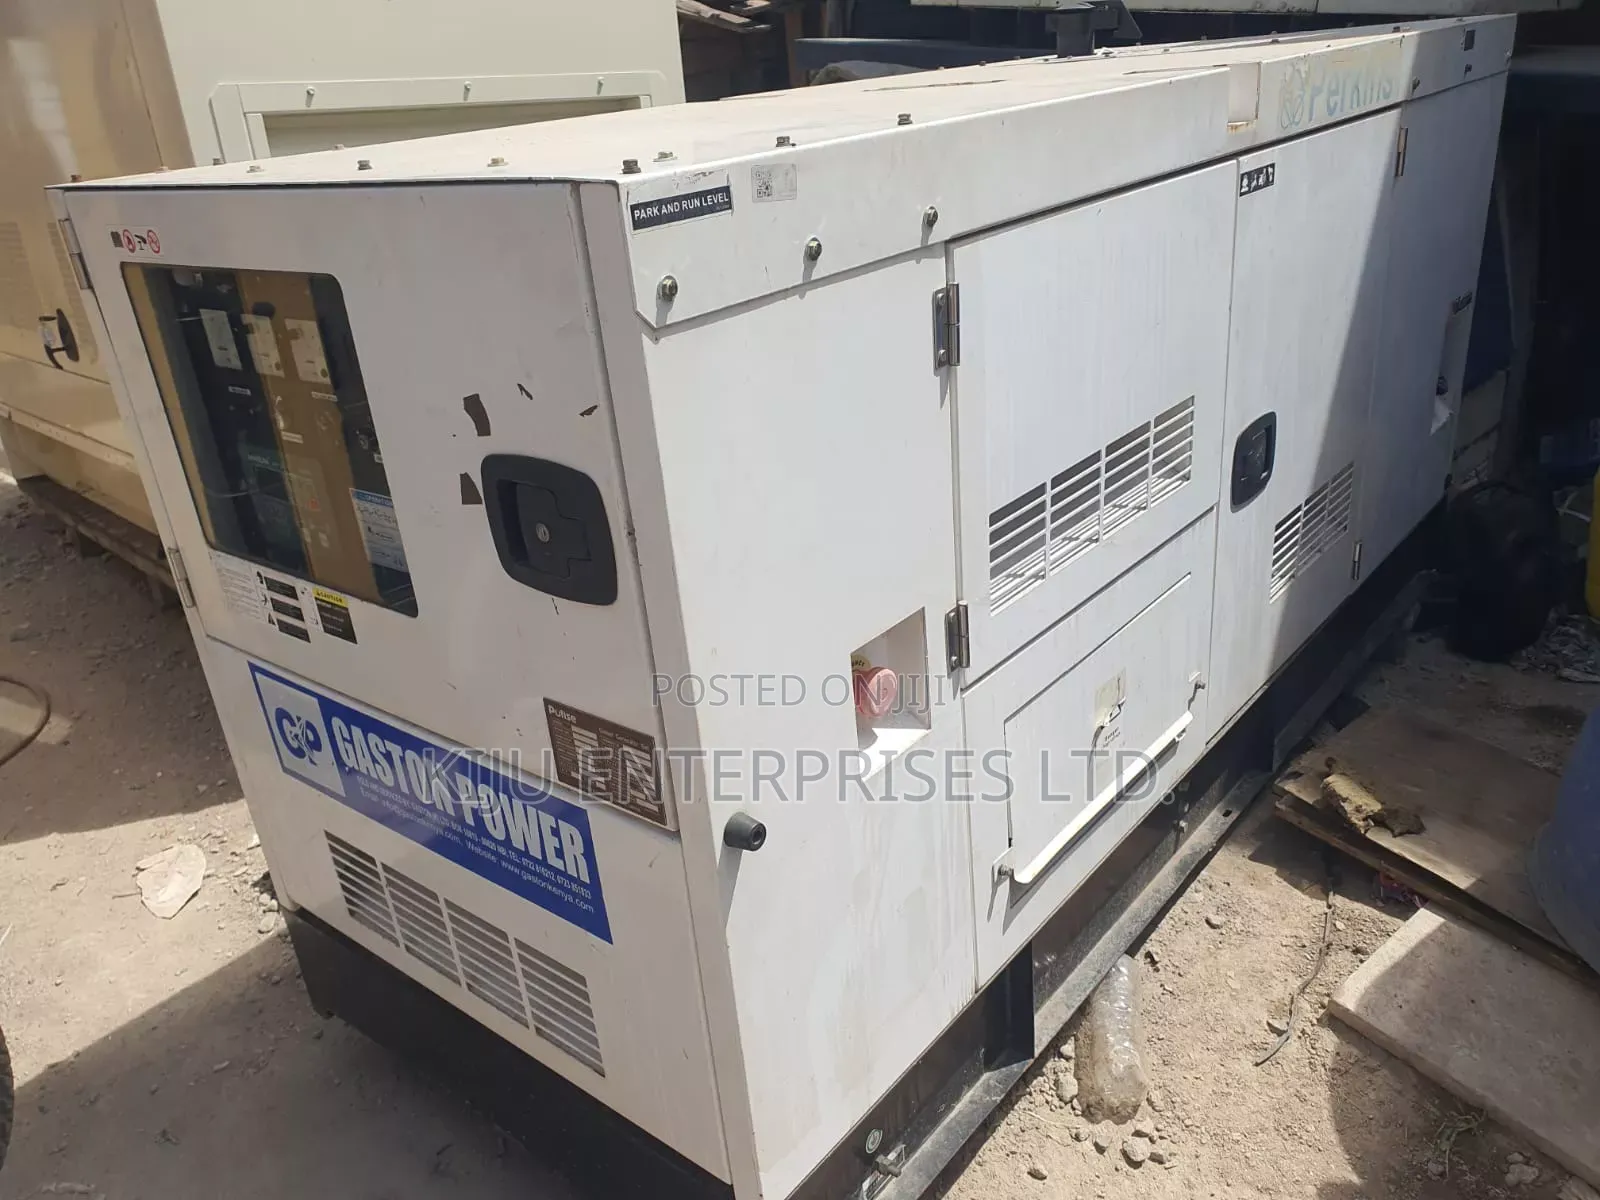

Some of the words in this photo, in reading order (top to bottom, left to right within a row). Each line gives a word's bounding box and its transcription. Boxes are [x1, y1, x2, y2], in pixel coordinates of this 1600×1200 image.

[634, 205, 660, 220] PARK
[661, 201, 680, 215] AND
[682, 197, 701, 211] RUN
[702, 192, 730, 206] LEVEL
[455, 772, 591, 884] POWER
